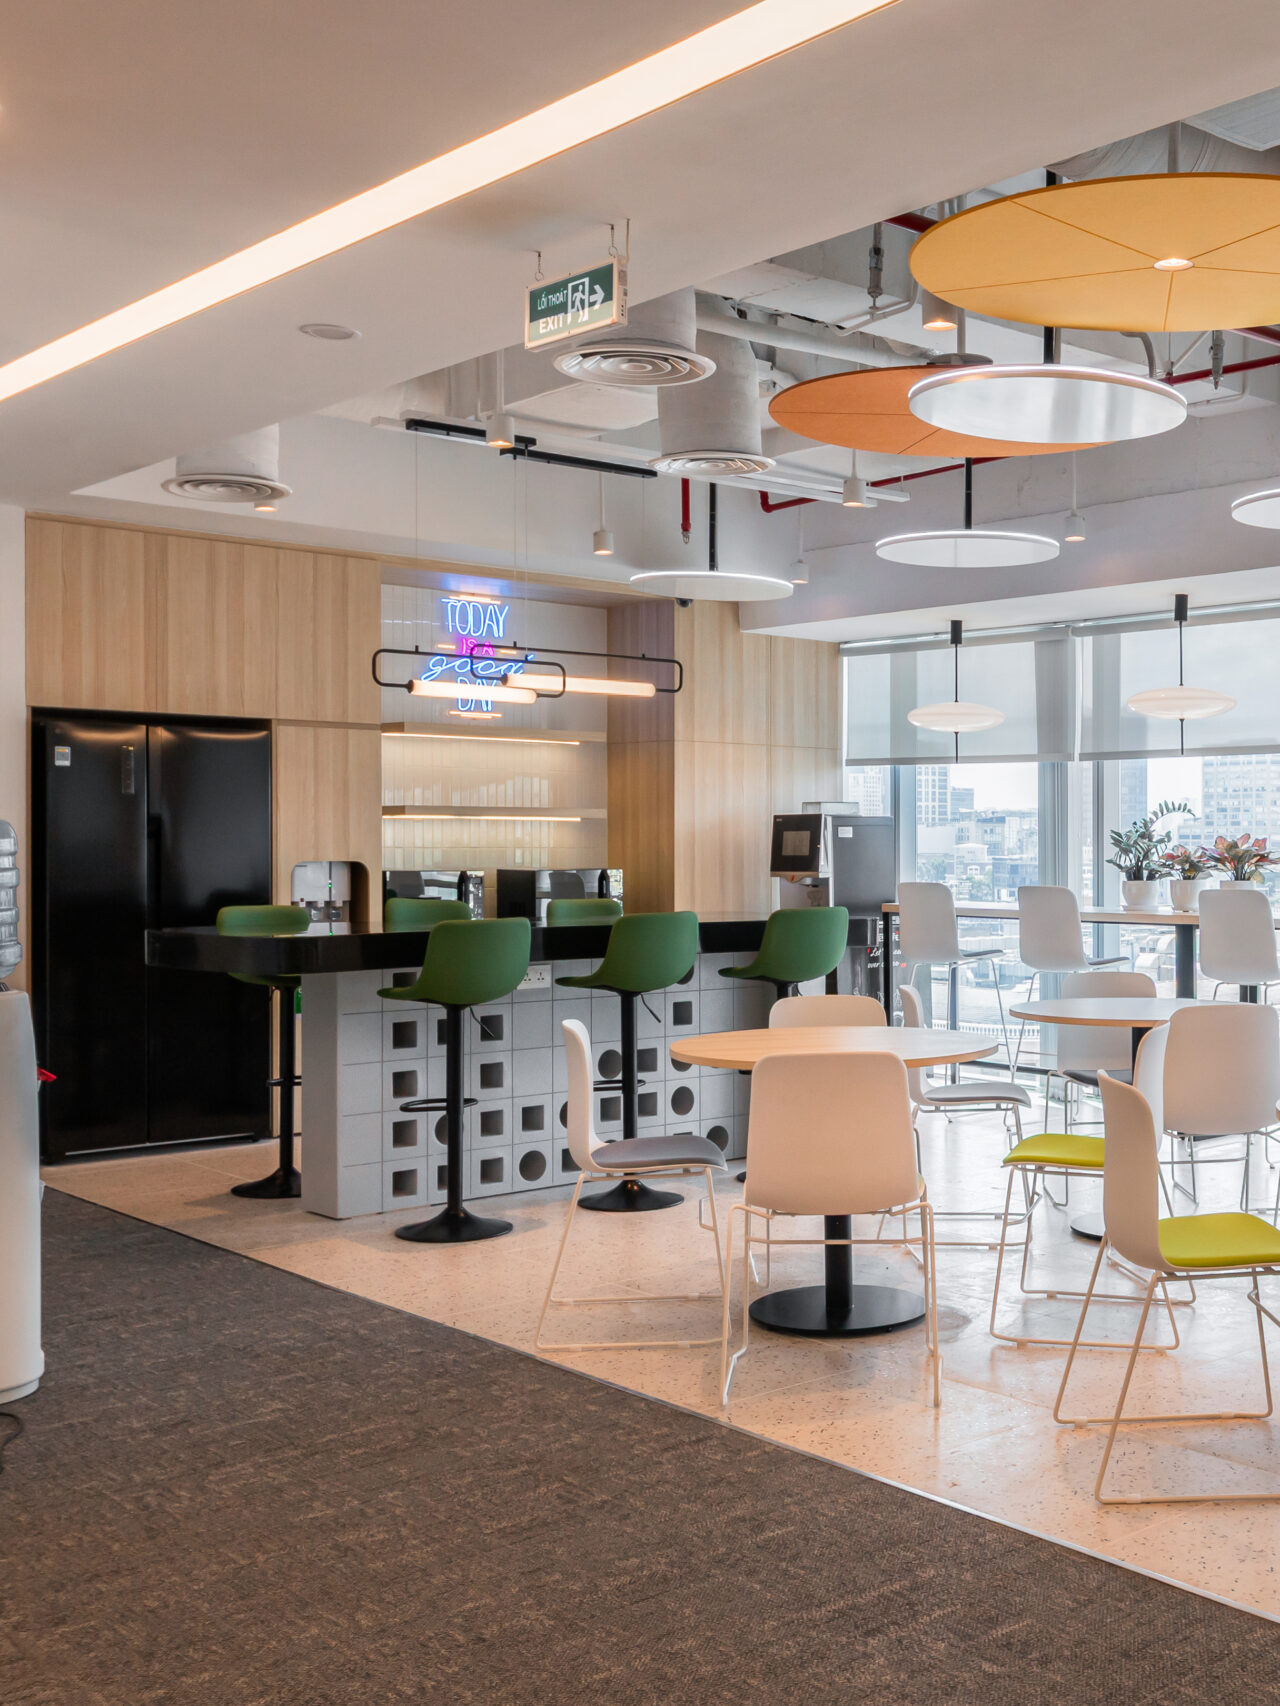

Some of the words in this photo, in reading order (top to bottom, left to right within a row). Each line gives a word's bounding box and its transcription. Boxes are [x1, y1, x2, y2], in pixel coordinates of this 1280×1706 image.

[548, 288, 567, 307] THOÁT
[539, 312, 565, 334] EXIT
[441, 598, 509, 638] TODAY
[461, 638, 478, 655] IS
[457, 676, 497, 711] DAY
